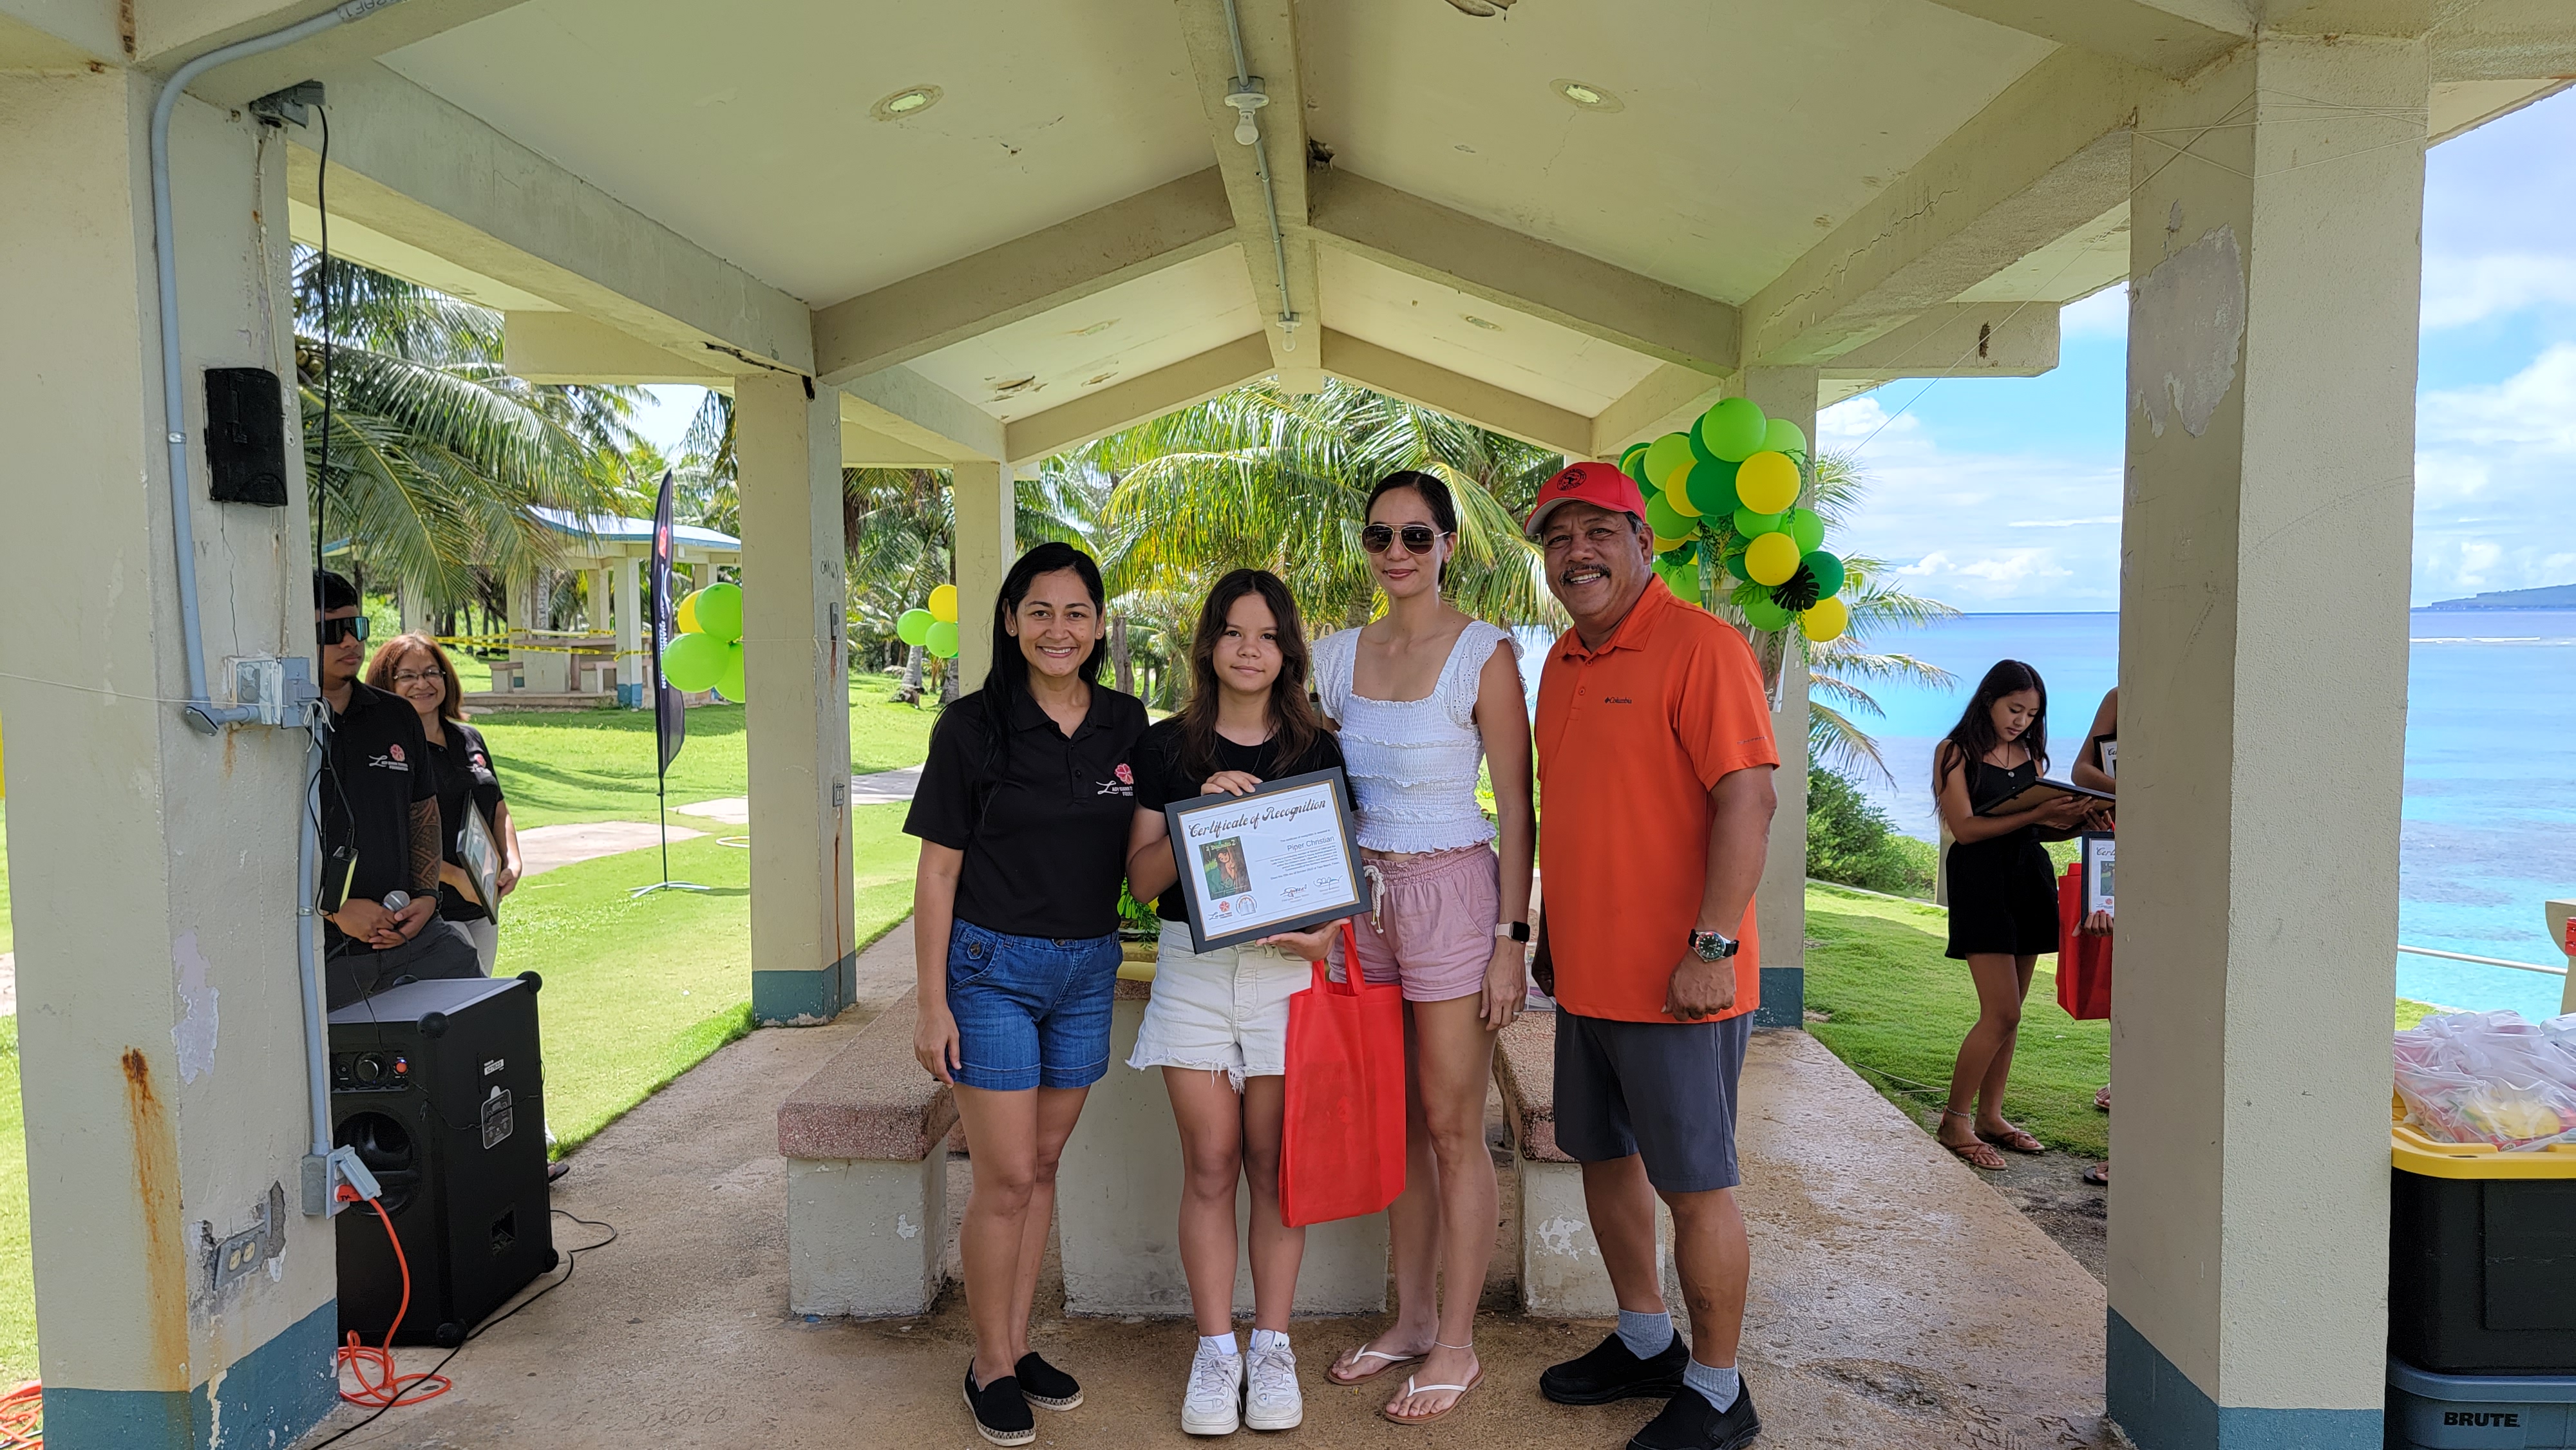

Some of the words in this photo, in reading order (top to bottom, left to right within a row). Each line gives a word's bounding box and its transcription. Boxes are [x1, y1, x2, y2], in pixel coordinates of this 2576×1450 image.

[1188, 813, 1248, 838] Certificate
[1249, 813, 1260, 829] of
[1262, 798, 1327, 822] Recognition
[1287, 843, 1305, 852] Piper
[1306, 836, 1336, 847] Christian
[2443, 1411, 2519, 1427] BRUTE
